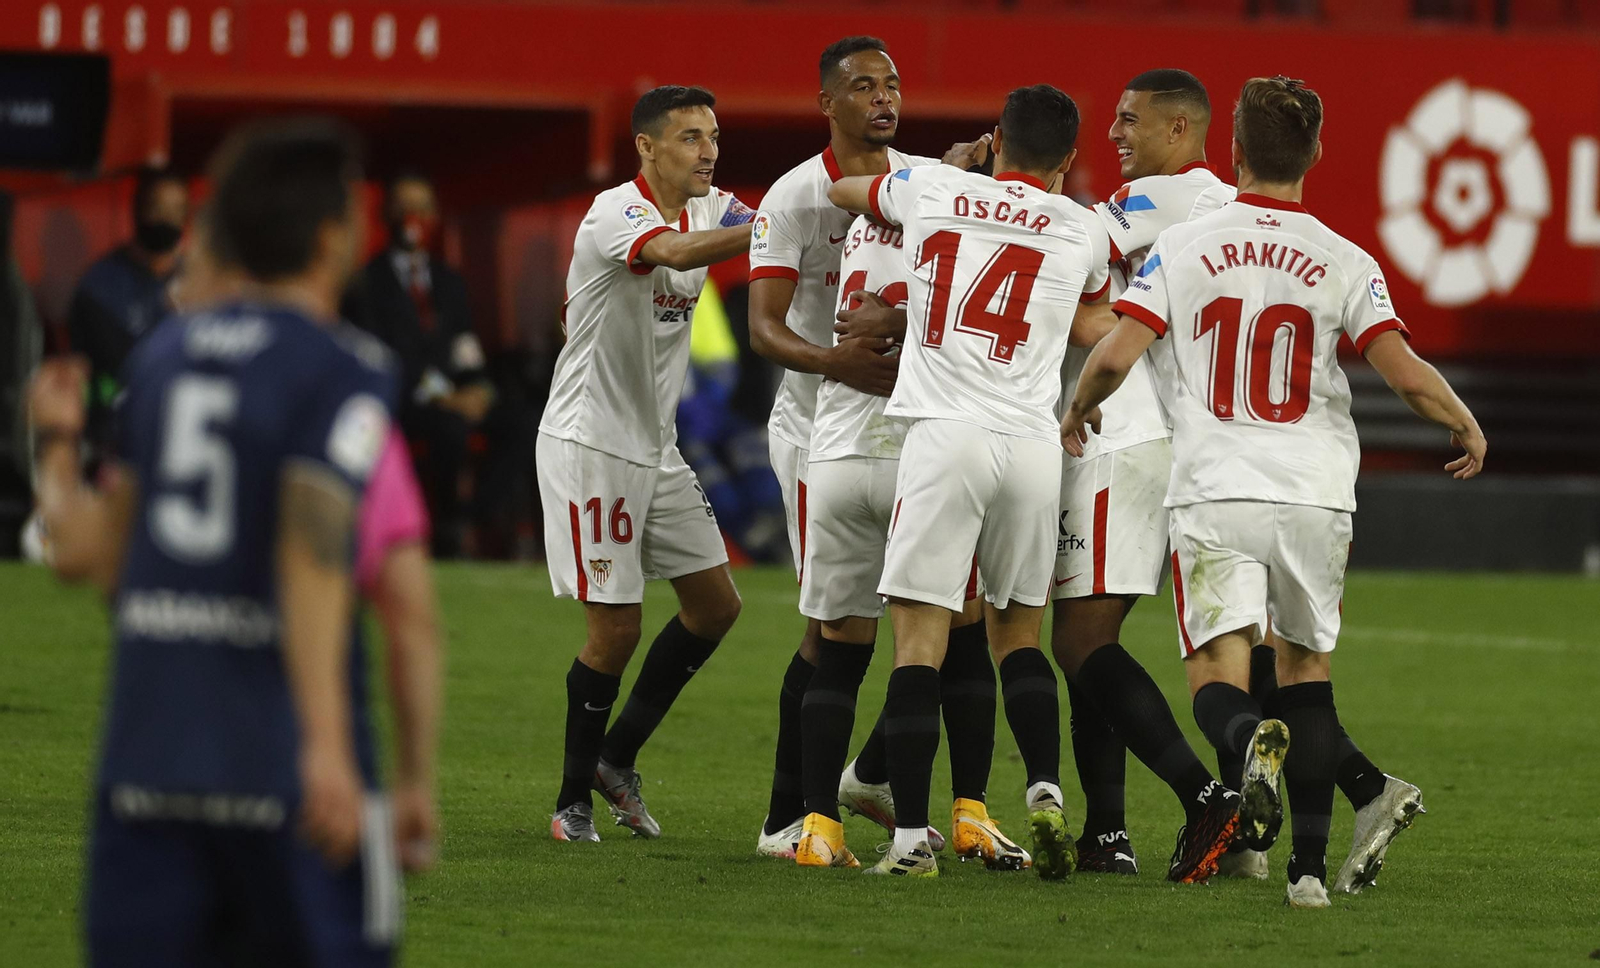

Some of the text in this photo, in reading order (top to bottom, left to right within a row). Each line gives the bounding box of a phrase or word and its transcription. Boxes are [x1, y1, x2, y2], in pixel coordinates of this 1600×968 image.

[953, 193, 1051, 234] ÓSCAR
[914, 230, 1046, 365] 14
[1193, 296, 1315, 425] 10
[153, 374, 237, 562] 5
[584, 497, 634, 545] 16
